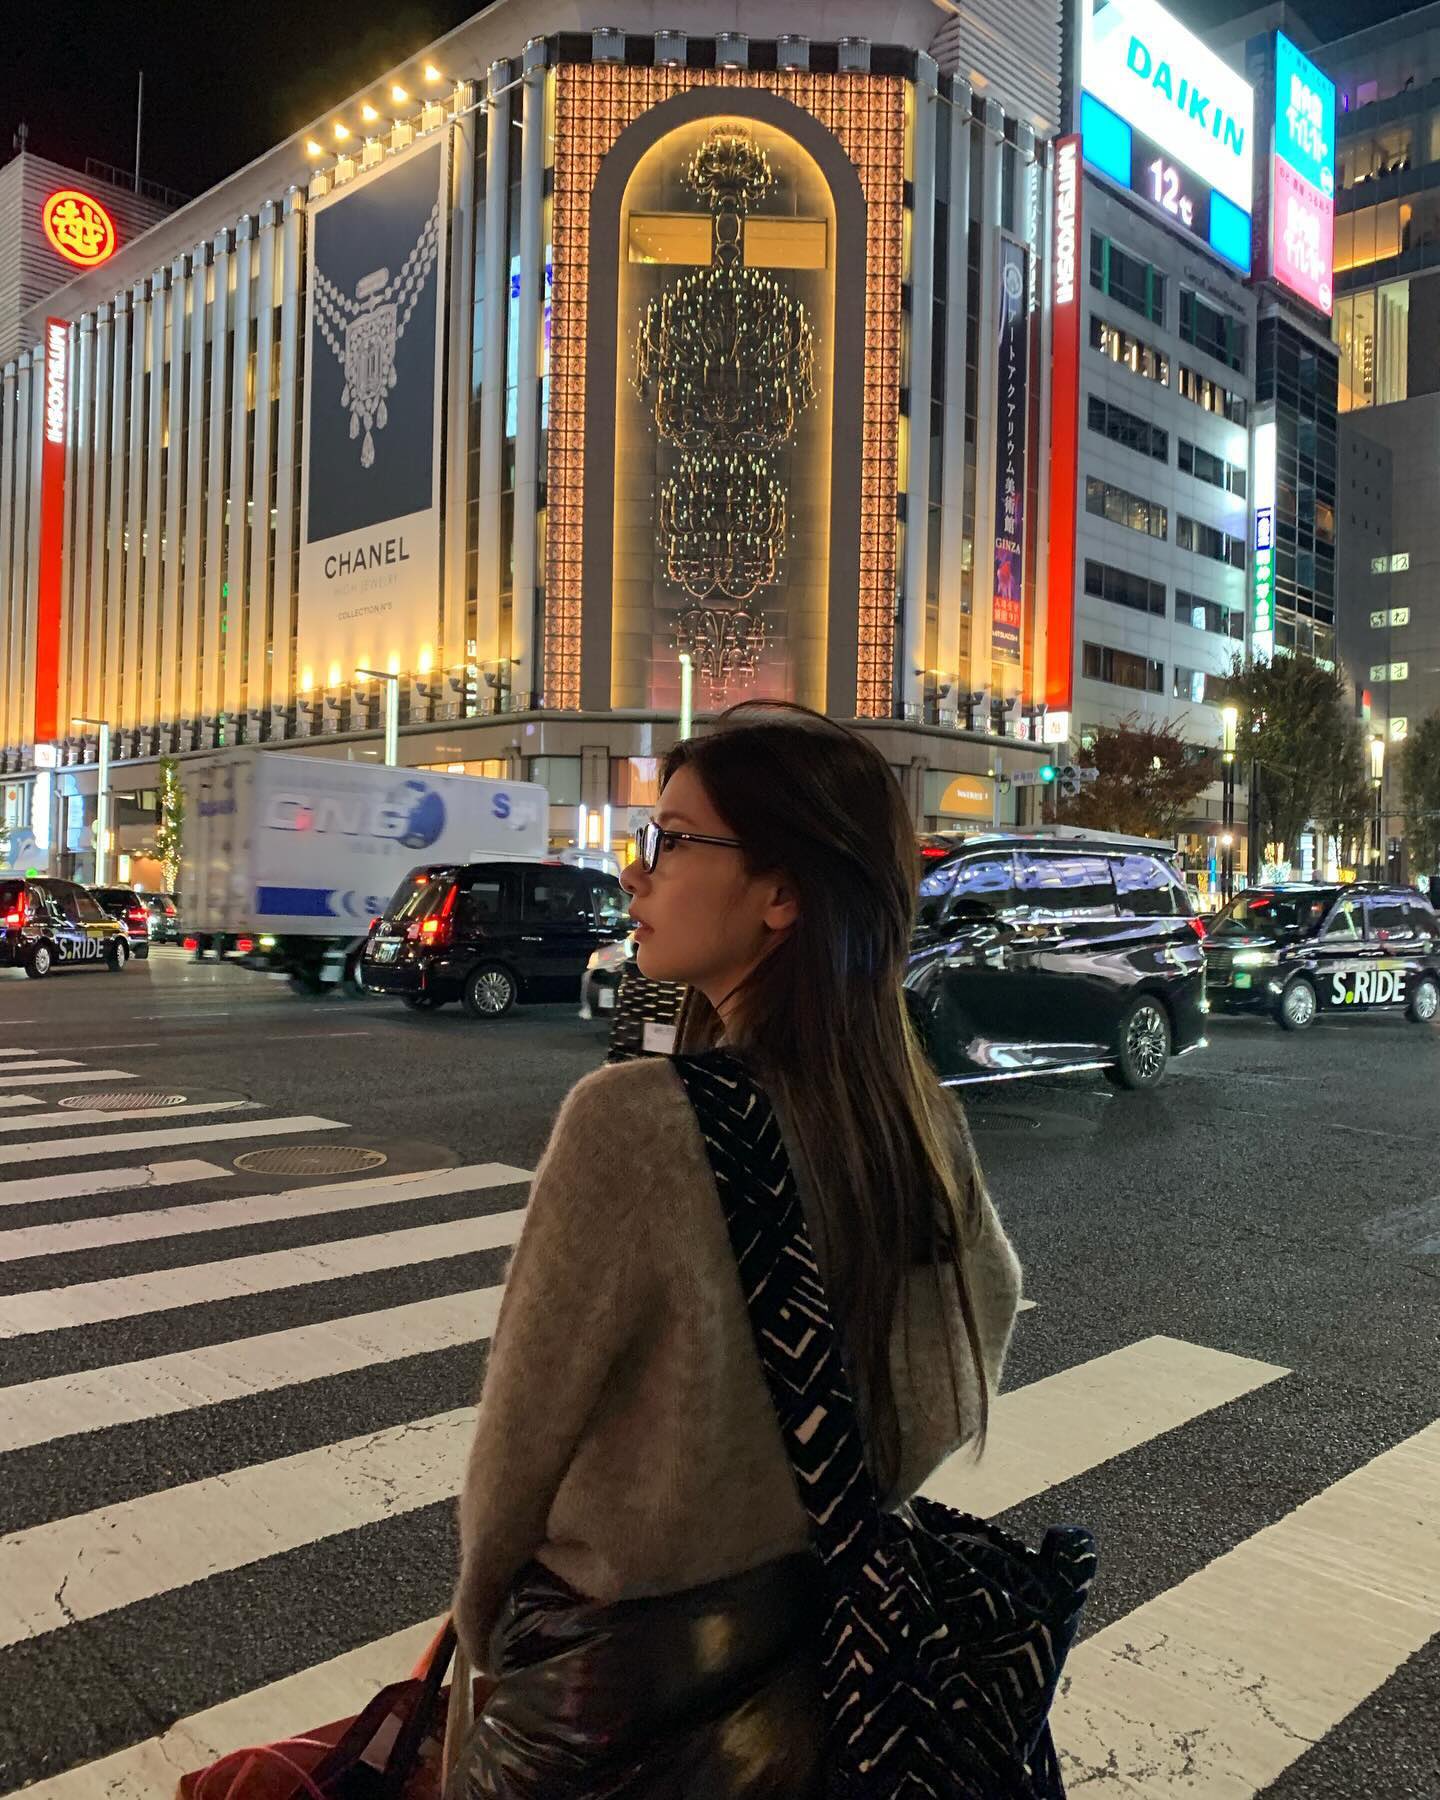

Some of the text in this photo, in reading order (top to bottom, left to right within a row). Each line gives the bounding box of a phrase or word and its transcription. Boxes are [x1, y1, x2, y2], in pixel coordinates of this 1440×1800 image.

[1126, 35, 1245, 157] DAIKIN
[1056, 143, 1077, 304] MITSUKOSHI
[47, 324, 67, 443] MITSUKOSHI
[324, 536, 410, 579] CHANEL
[995, 537, 1021, 555] GINZA
[338, 604, 380, 621] COLLECTION
[59, 936, 104, 960] S.RIDE
[1331, 969, 1407, 1005] S.RIDE
